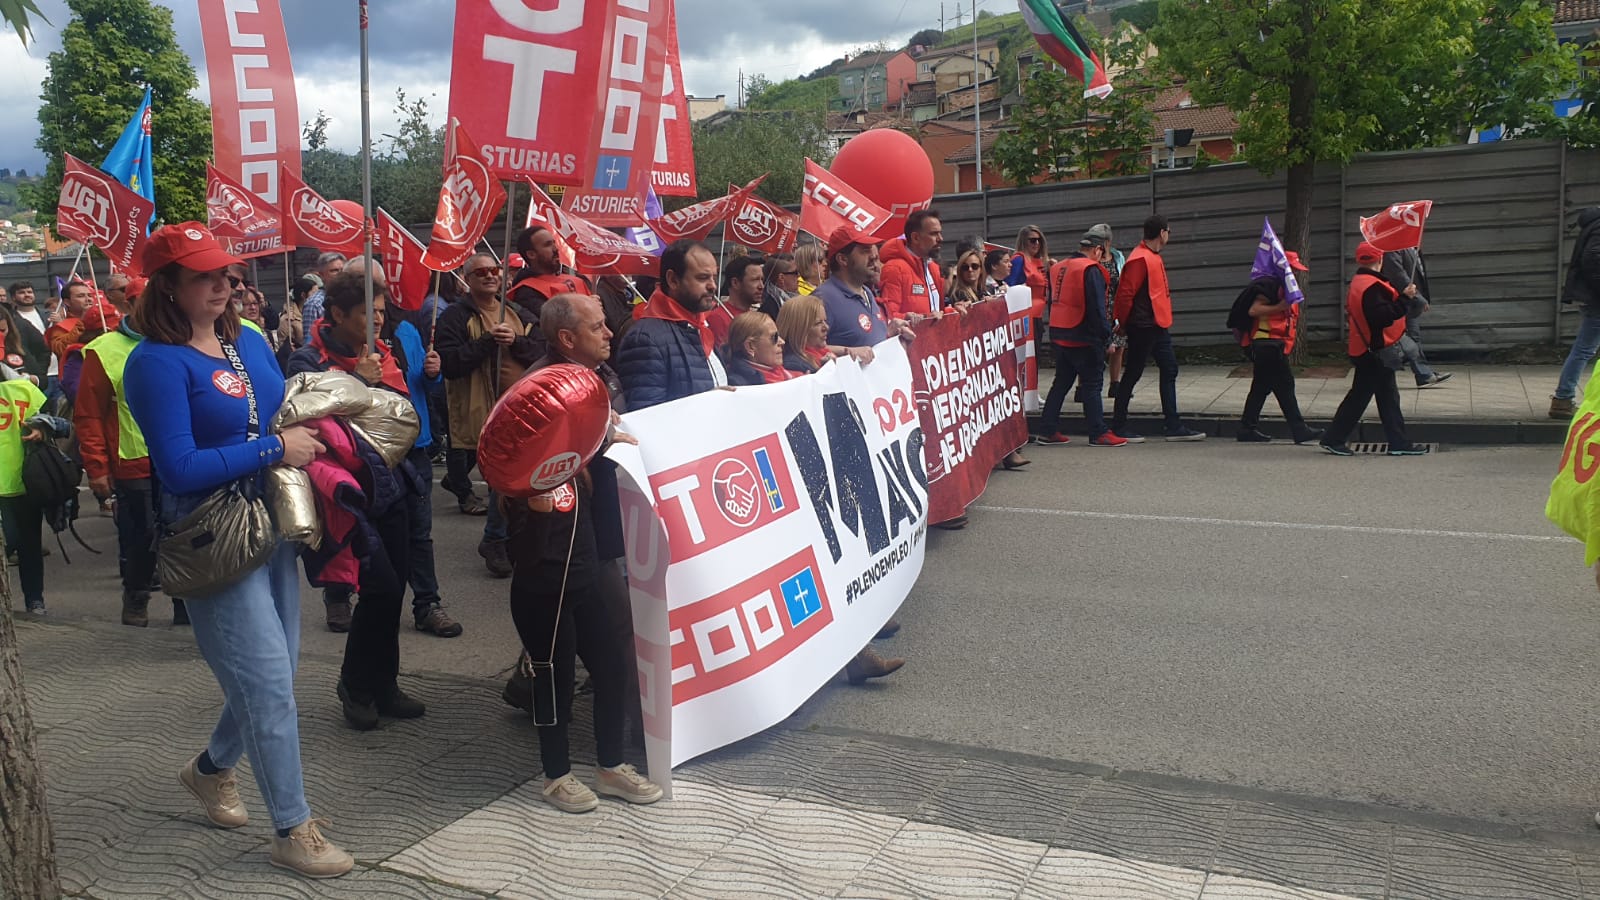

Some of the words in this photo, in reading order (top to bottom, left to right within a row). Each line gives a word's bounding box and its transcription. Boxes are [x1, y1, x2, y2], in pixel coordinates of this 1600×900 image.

[481, 144, 577, 175] STURIAS
[651, 170, 691, 187] TURIAS
[60, 178, 110, 228] UGT
[569, 194, 640, 214] ASTURIES
[803, 174, 875, 229] CCOO
[739, 203, 774, 229] UGT
[122, 206, 141, 267] www.ugt.es
[226, 236, 281, 255] ASTURIE
[222, 343, 245, 370] 1980
[538, 455, 577, 479] UGT
[553, 483, 572, 500] UGT
[845, 544, 909, 606] #PLENOEMPLEO
